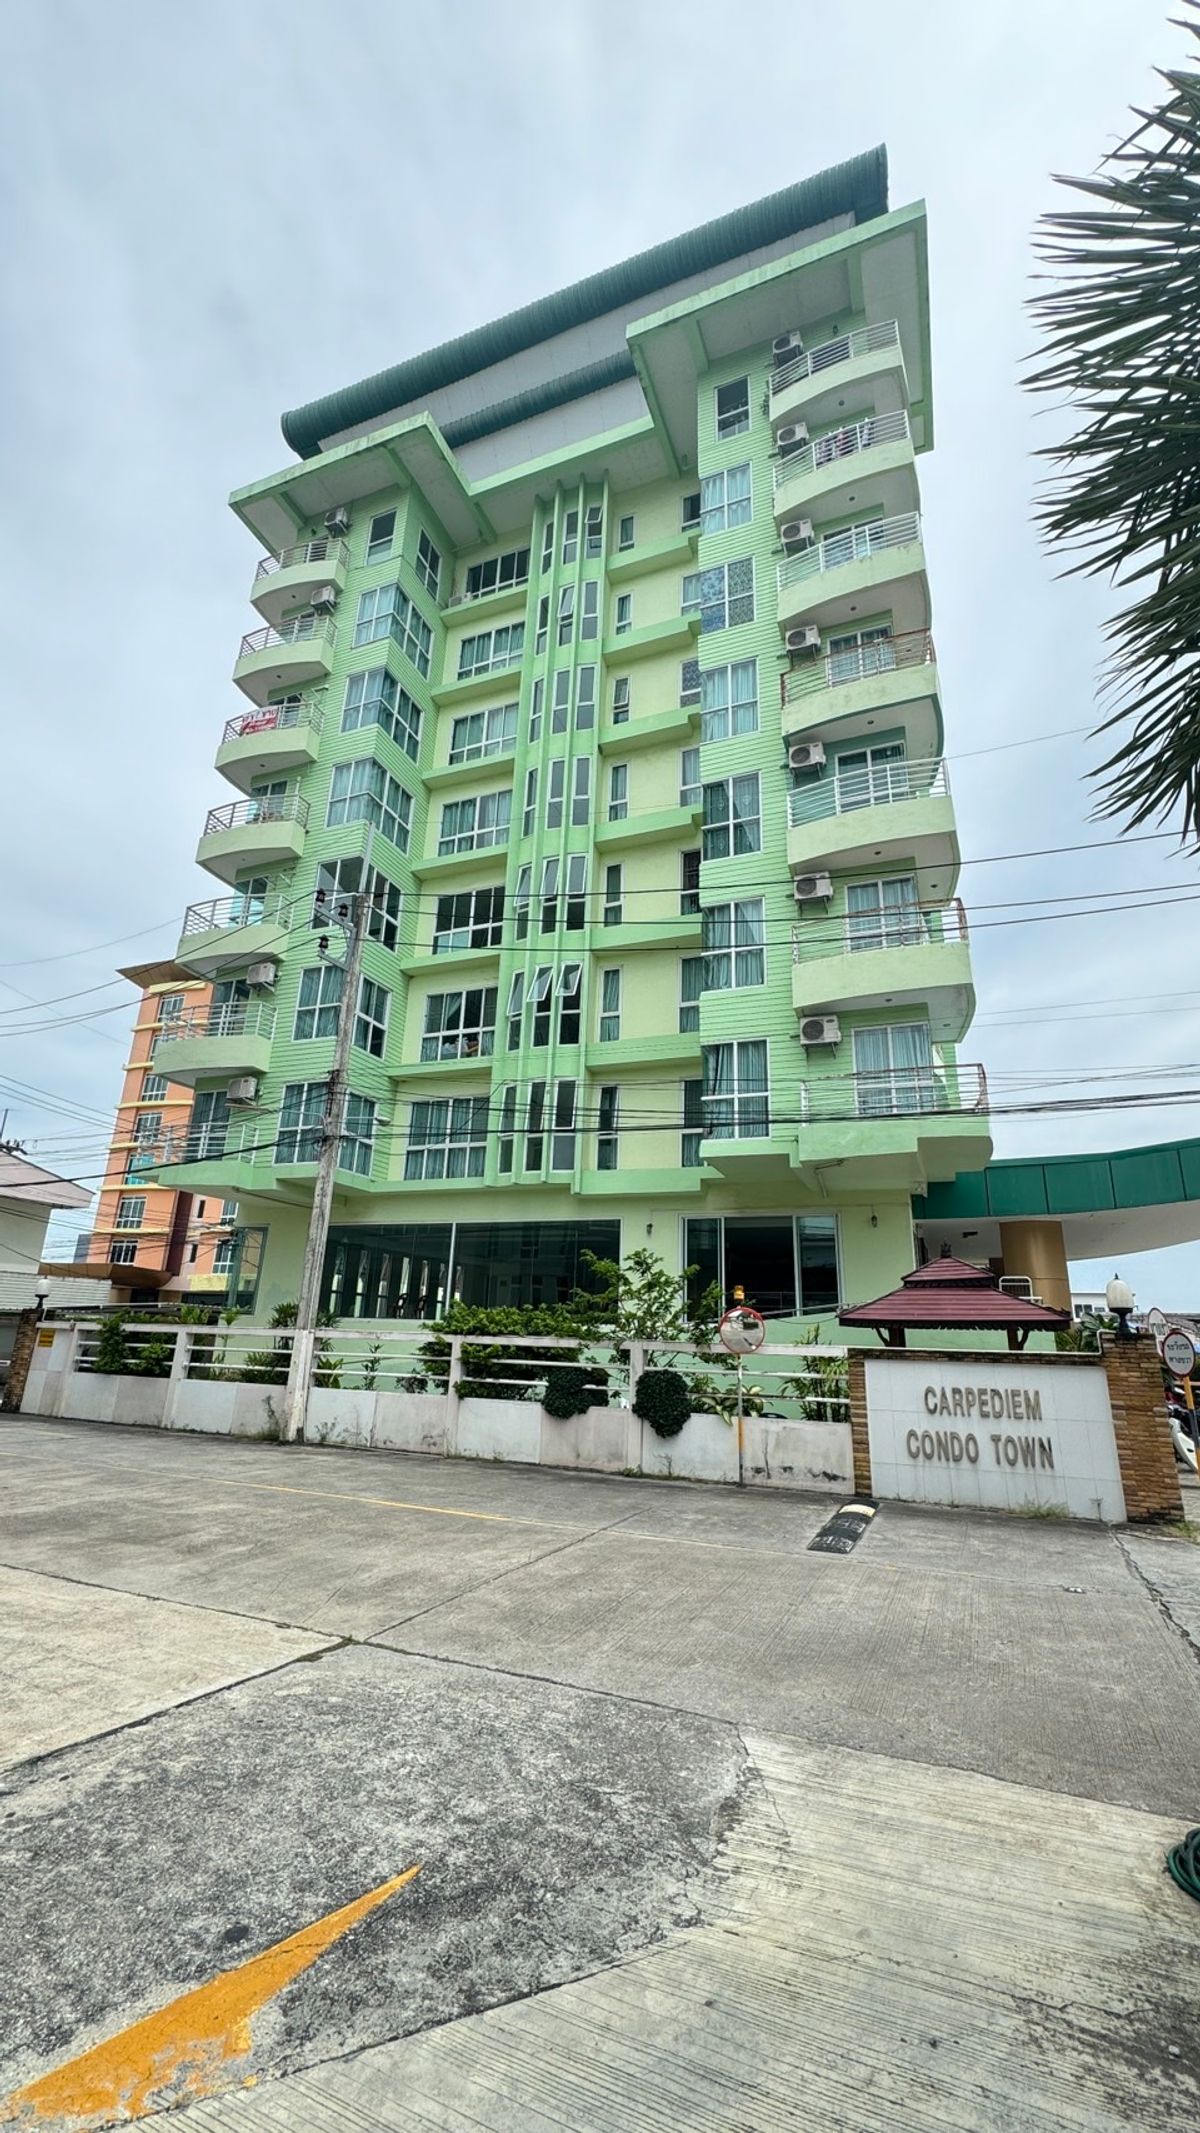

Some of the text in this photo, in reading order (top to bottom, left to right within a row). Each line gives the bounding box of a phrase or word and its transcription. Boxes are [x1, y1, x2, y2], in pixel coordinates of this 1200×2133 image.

[924, 1385, 1043, 1421] CARPEDIEM
[906, 1428, 1055, 1470] CONDO TOWN
